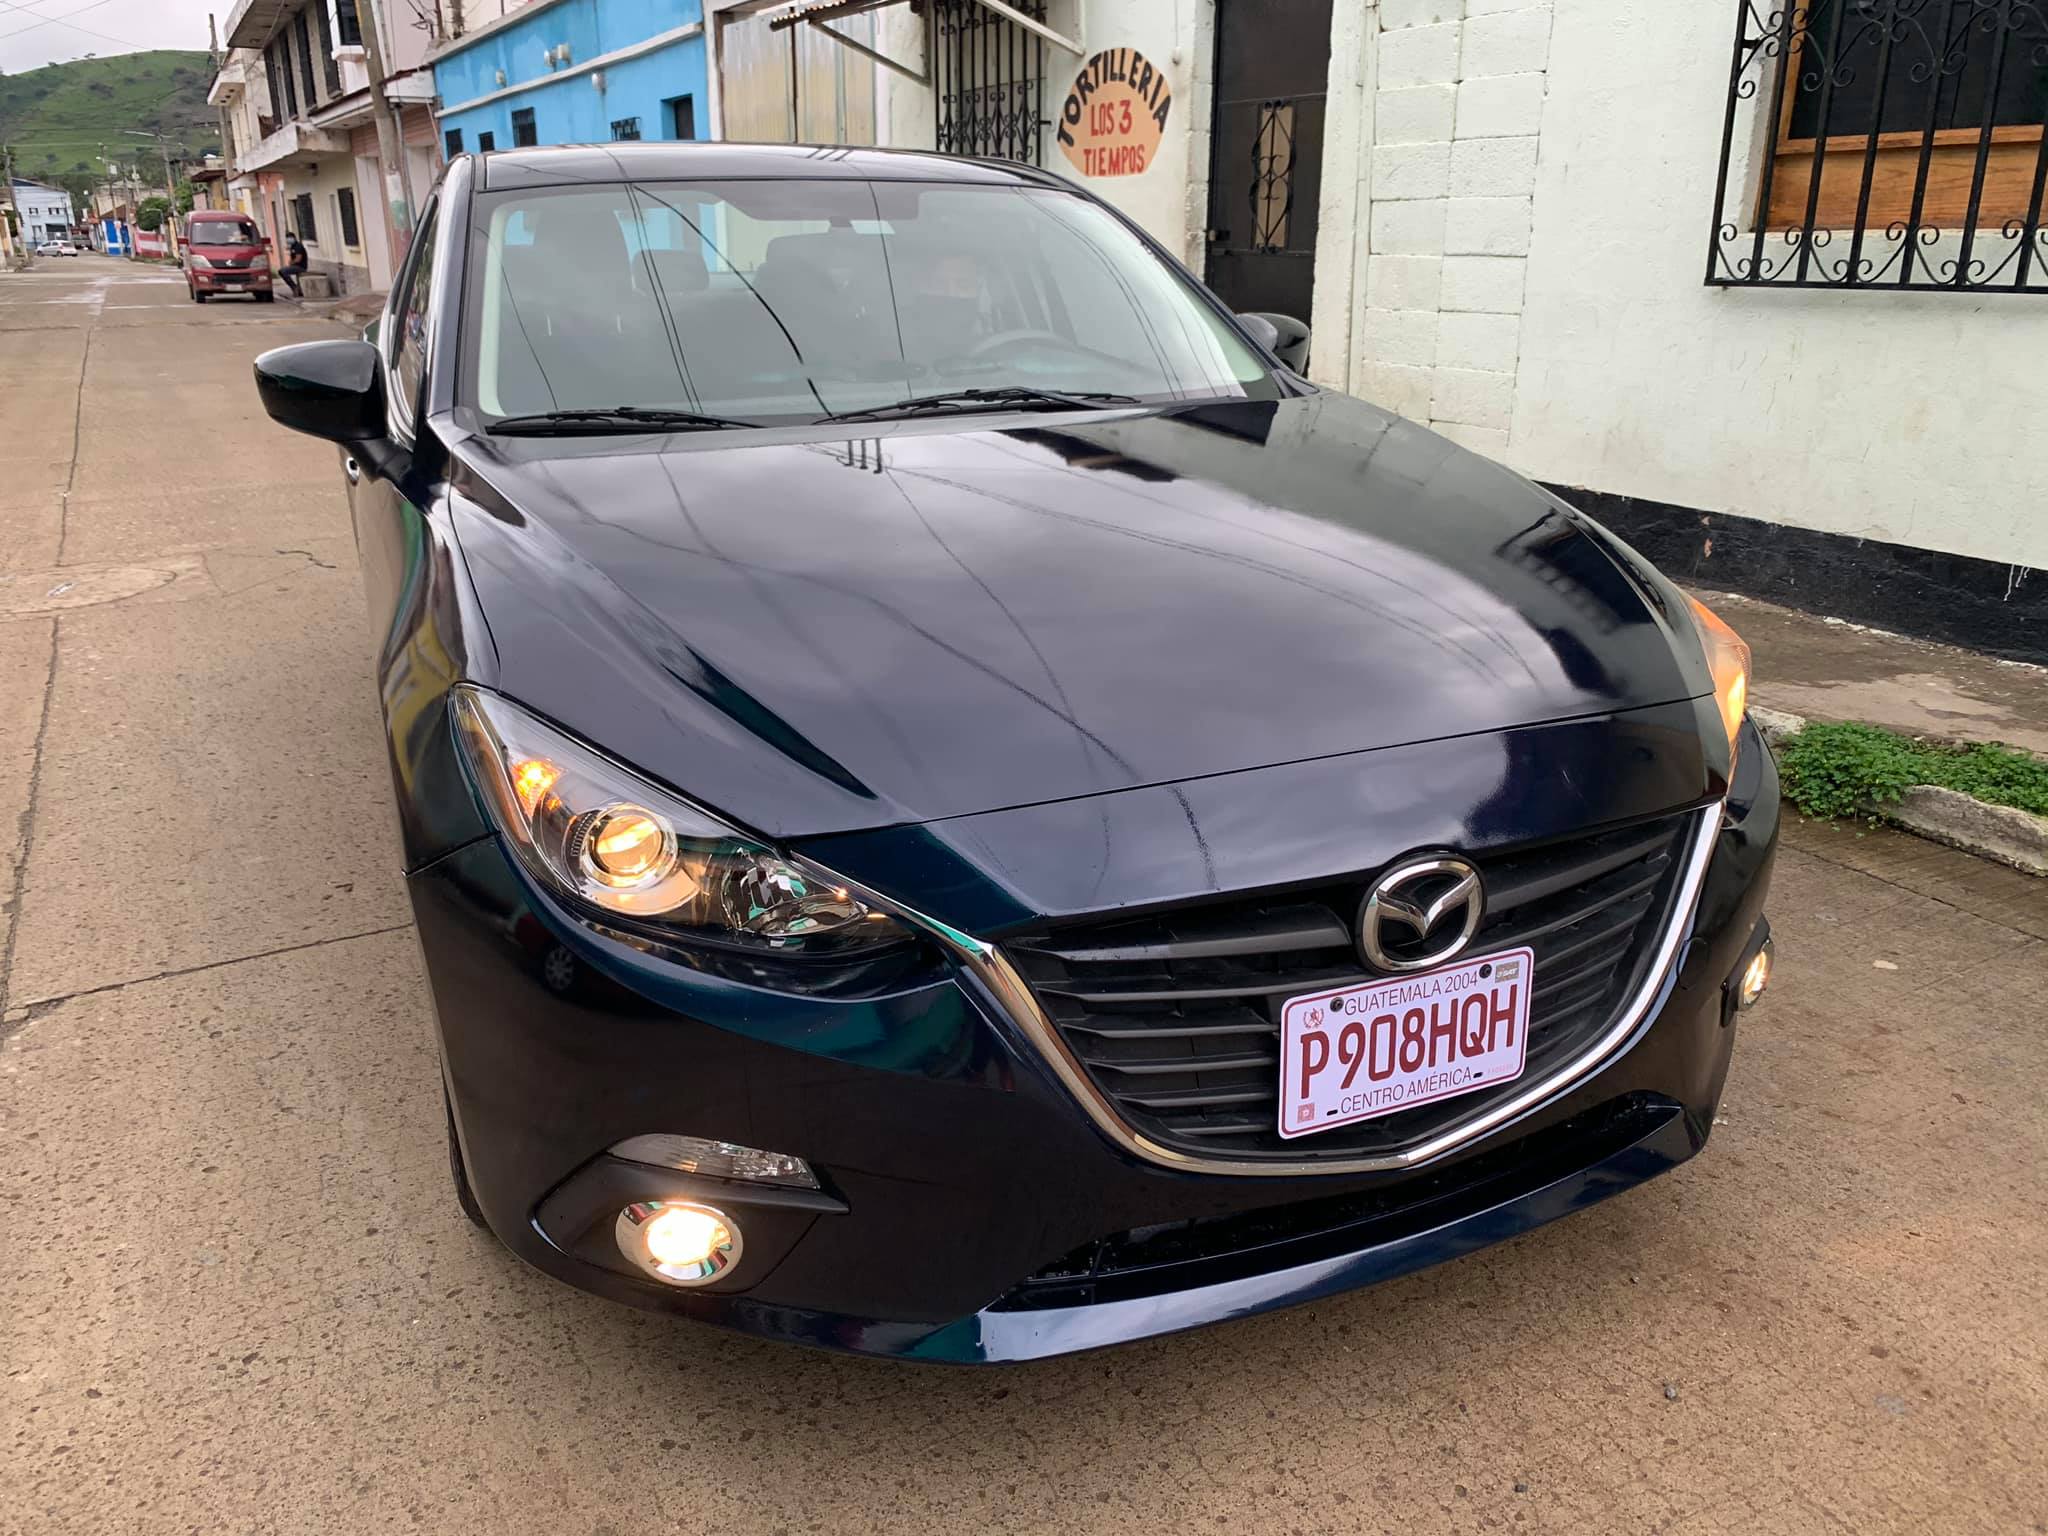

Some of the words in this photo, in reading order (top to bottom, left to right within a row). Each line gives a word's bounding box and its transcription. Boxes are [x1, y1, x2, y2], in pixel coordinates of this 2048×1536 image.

[1057, 47, 1171, 147] TORTILLERIA
[1091, 102, 1114, 136] LOS
[1119, 99, 1132, 134] 3
[1083, 144, 1145, 177] TIEMPOS
[1344, 982, 1441, 1016] GUATEMALA
[1445, 970, 1478, 994] 2004
[1340, 1083, 1404, 1114] CENTRO
[1407, 1066, 1472, 1098] AMÉRICA
